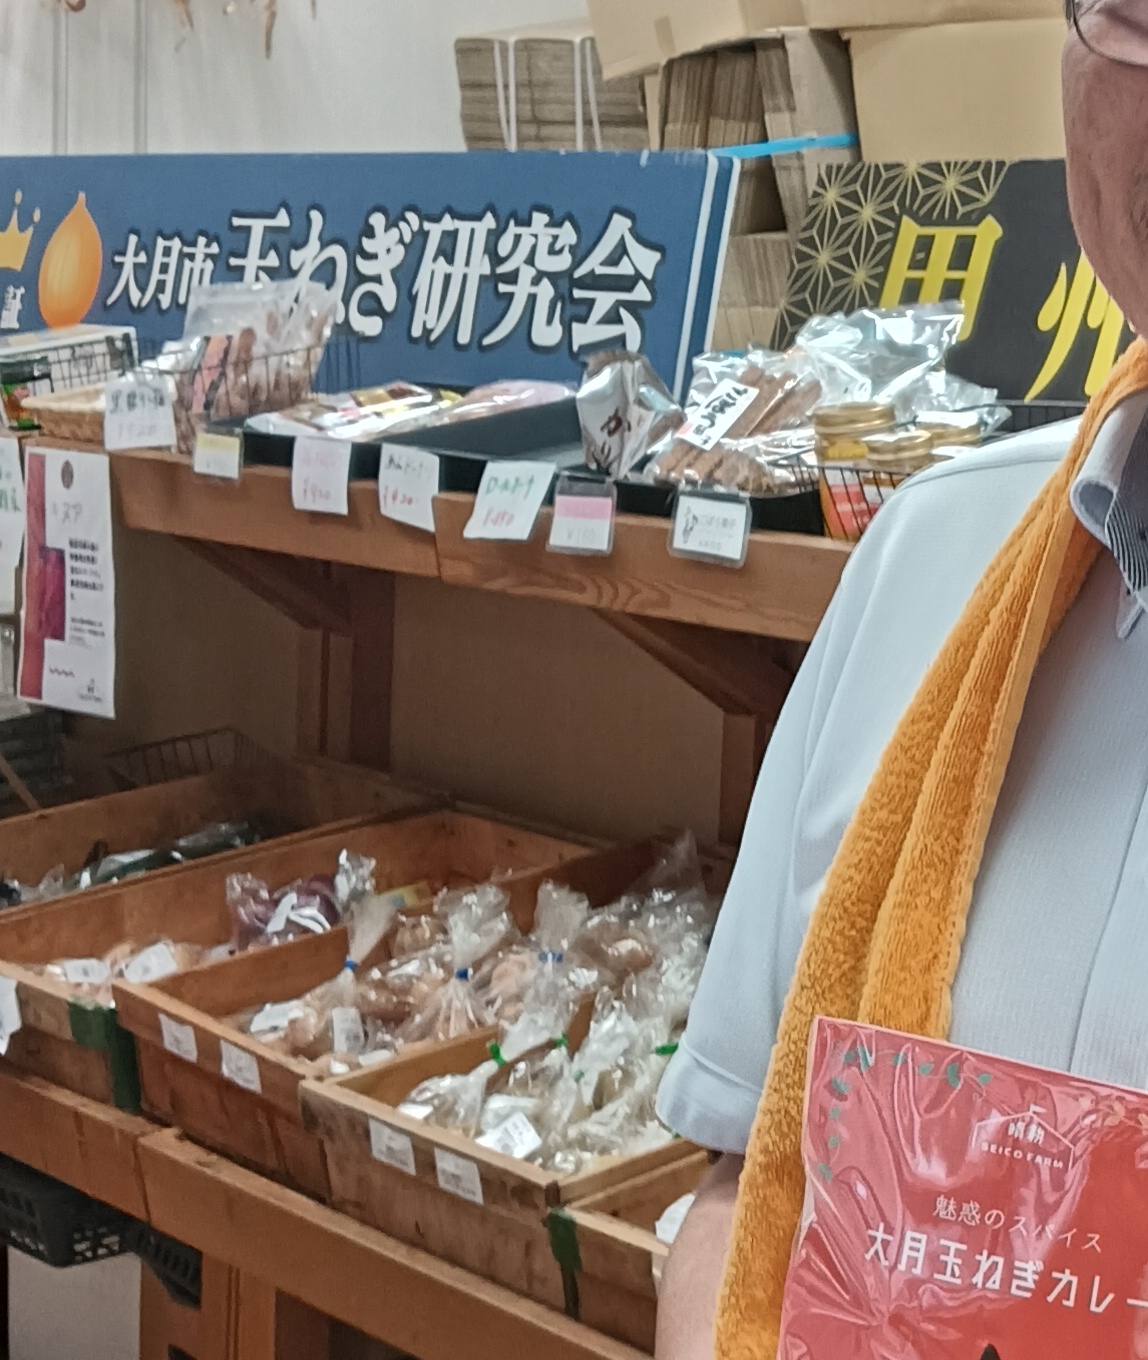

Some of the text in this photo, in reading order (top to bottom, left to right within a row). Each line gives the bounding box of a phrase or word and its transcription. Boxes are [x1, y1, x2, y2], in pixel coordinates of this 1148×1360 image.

[932, 1194, 1103, 1254] 魅惑のスパイス
